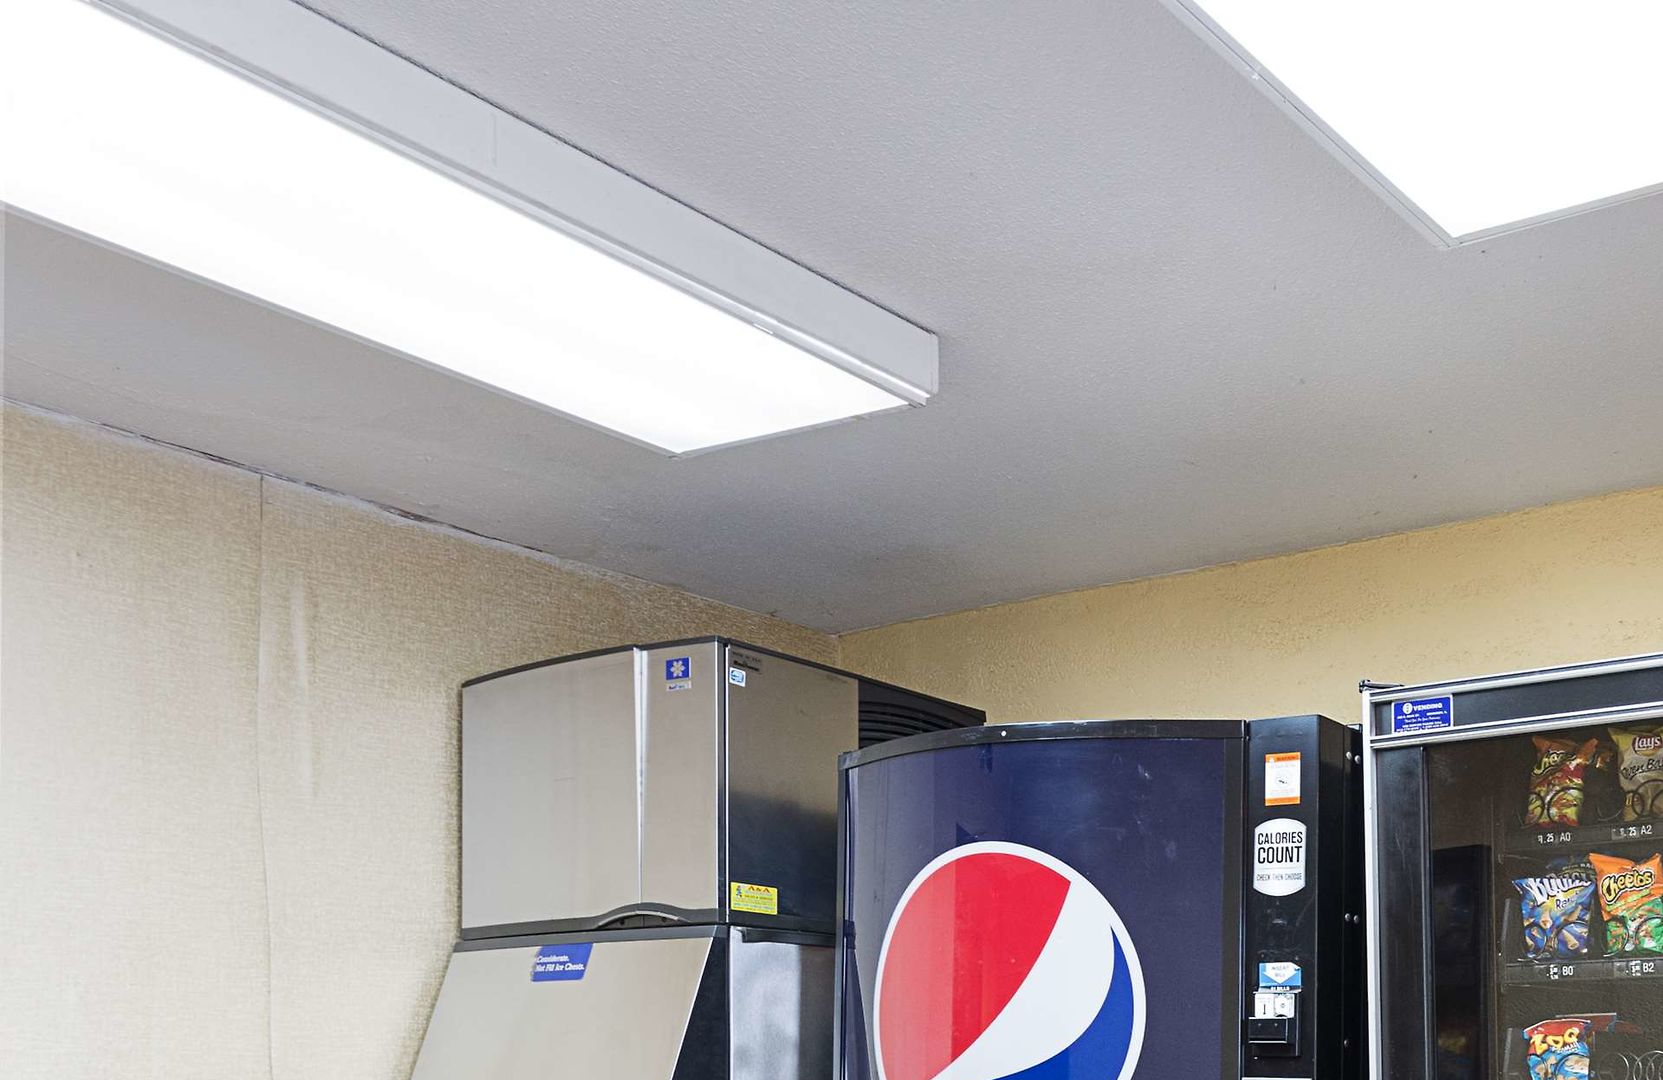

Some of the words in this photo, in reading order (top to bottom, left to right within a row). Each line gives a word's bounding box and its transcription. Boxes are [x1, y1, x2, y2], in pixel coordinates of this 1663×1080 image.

[1641, 825, 1652, 834] A2
[1257, 832, 1303, 845] CALORIES
[1257, 846, 1303, 864] COUNT
[1602, 873, 1653, 900] Cheetos
